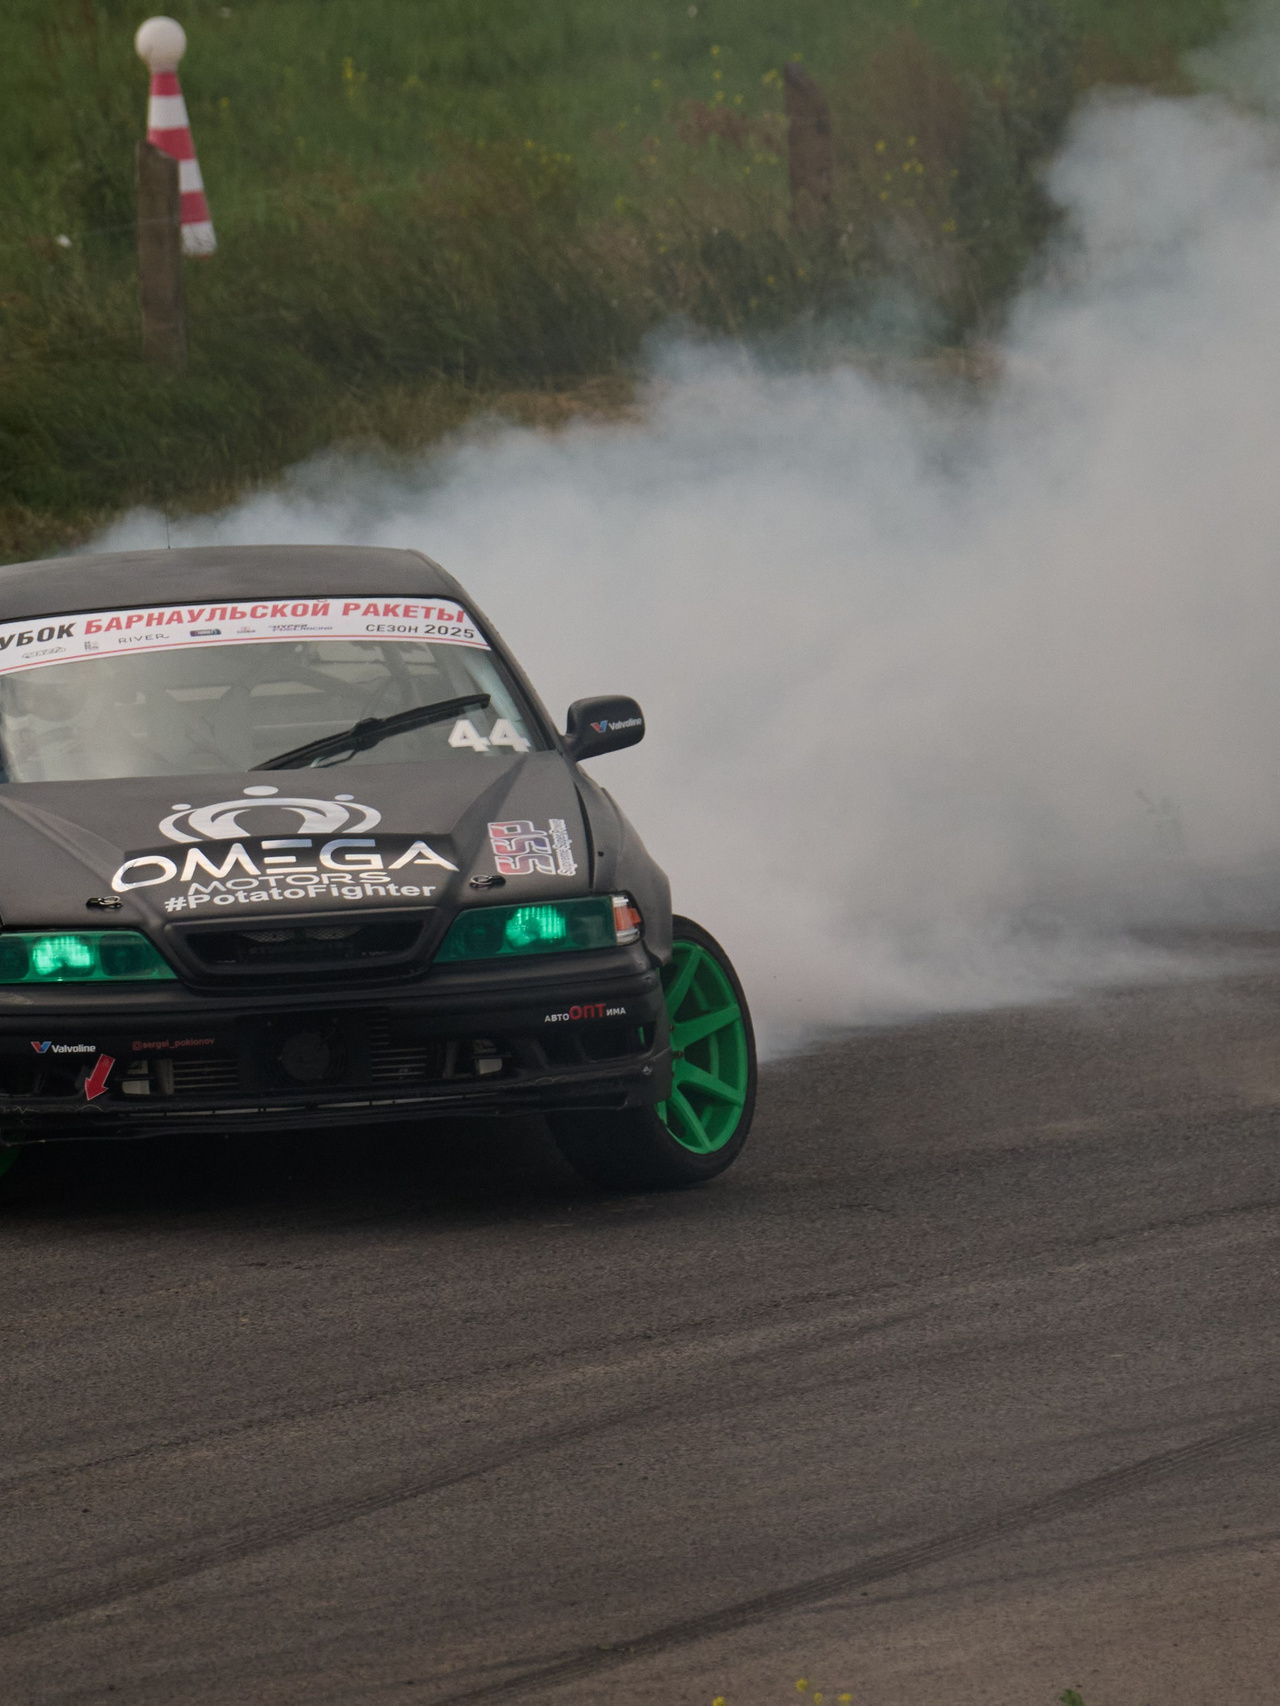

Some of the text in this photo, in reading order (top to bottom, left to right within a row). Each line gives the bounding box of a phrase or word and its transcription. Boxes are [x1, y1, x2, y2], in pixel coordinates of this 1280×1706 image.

[84, 600, 330, 635] БАРНАУЛЬСКОЙ
[342, 602, 466, 624] РАКЕТЫ
[365, 623, 475, 639] СЕЗОН 2025
[447, 718, 532, 753] 44
[609, 717, 643, 731] Valvoline
[111, 838, 460, 893] OMEGA
[187, 871, 392, 896] MOTORS
[164, 883, 437, 912] #PotatoFighter
[51, 1043, 96, 1054] Valvoline
